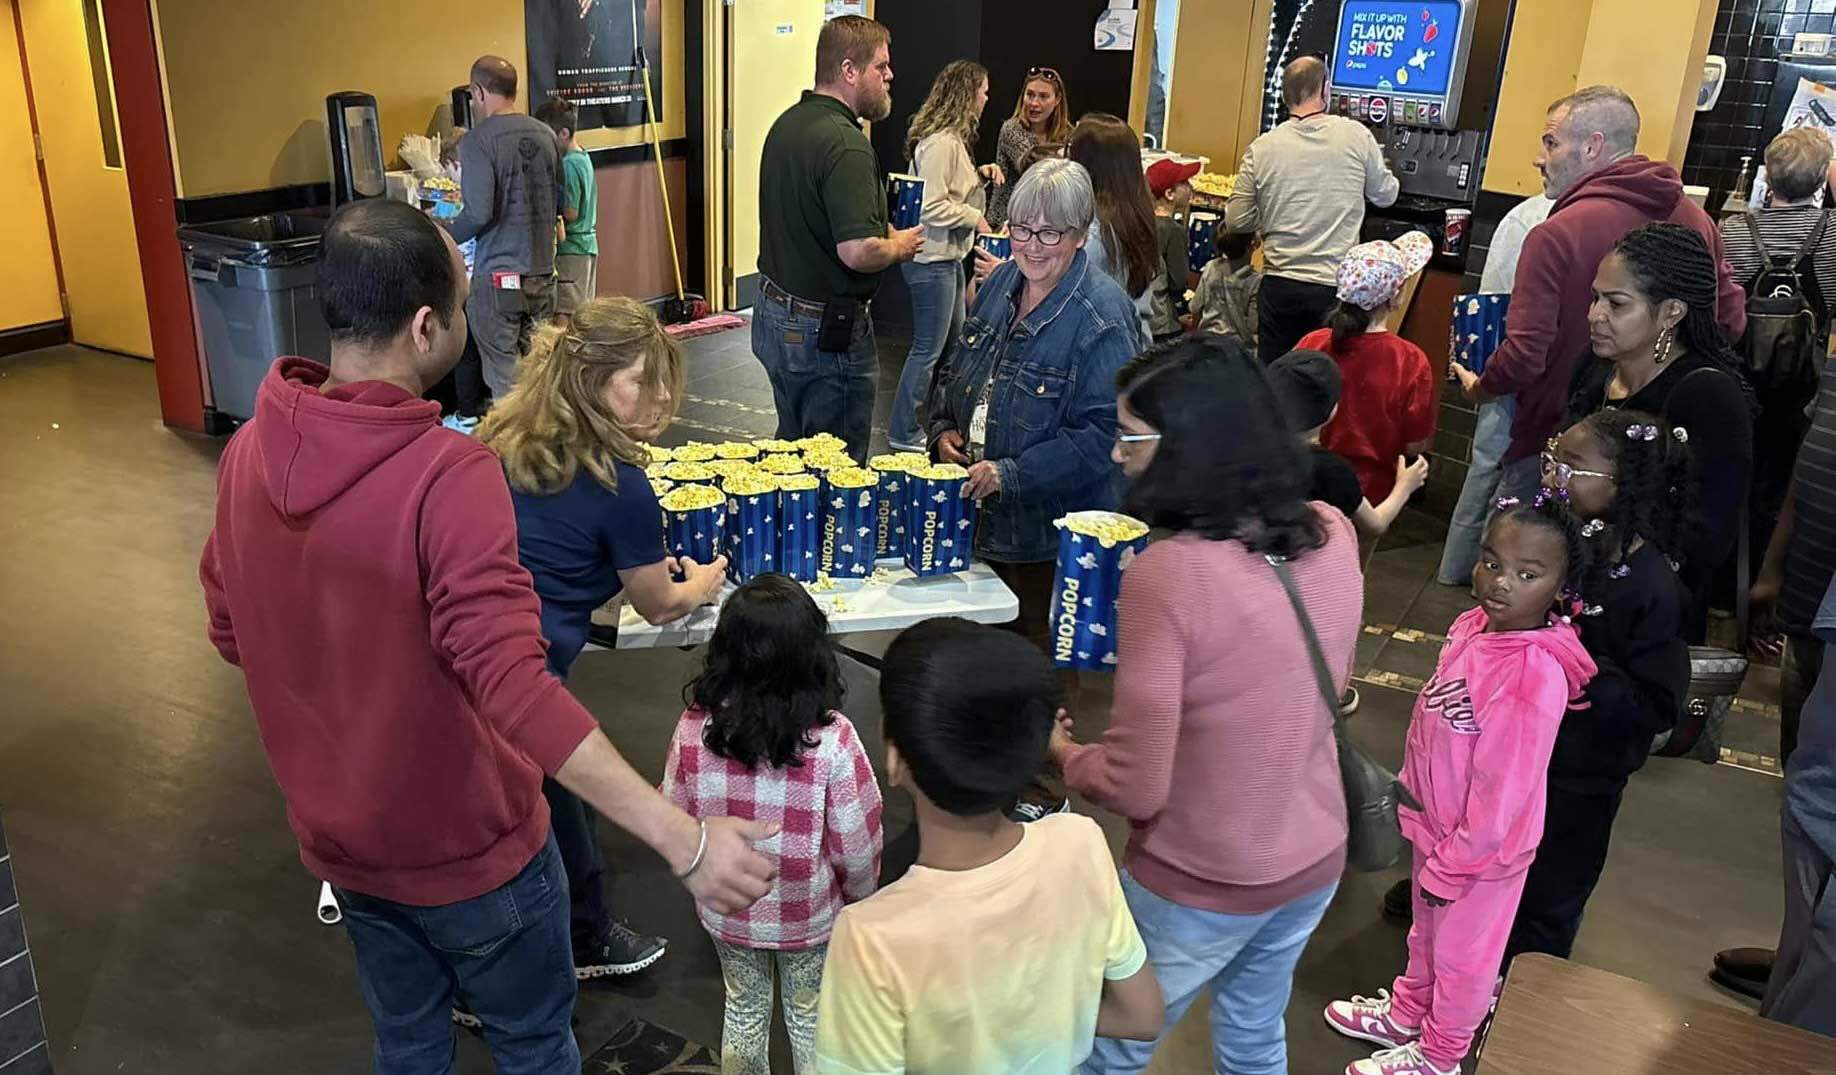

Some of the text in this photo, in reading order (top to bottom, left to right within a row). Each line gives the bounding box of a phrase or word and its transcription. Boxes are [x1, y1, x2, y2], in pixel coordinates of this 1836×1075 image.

[1351, 23, 1405, 41] FLAVOR
[1353, 12, 1408, 24] MIX IT UP WITH
[1348, 39, 1394, 58] SHOTS
[821, 514, 836, 571] POPCORN
[877, 499, 890, 554] POPCORN
[921, 510, 937, 571] POPCORN
[1055, 577, 1080, 661] POPCORN
